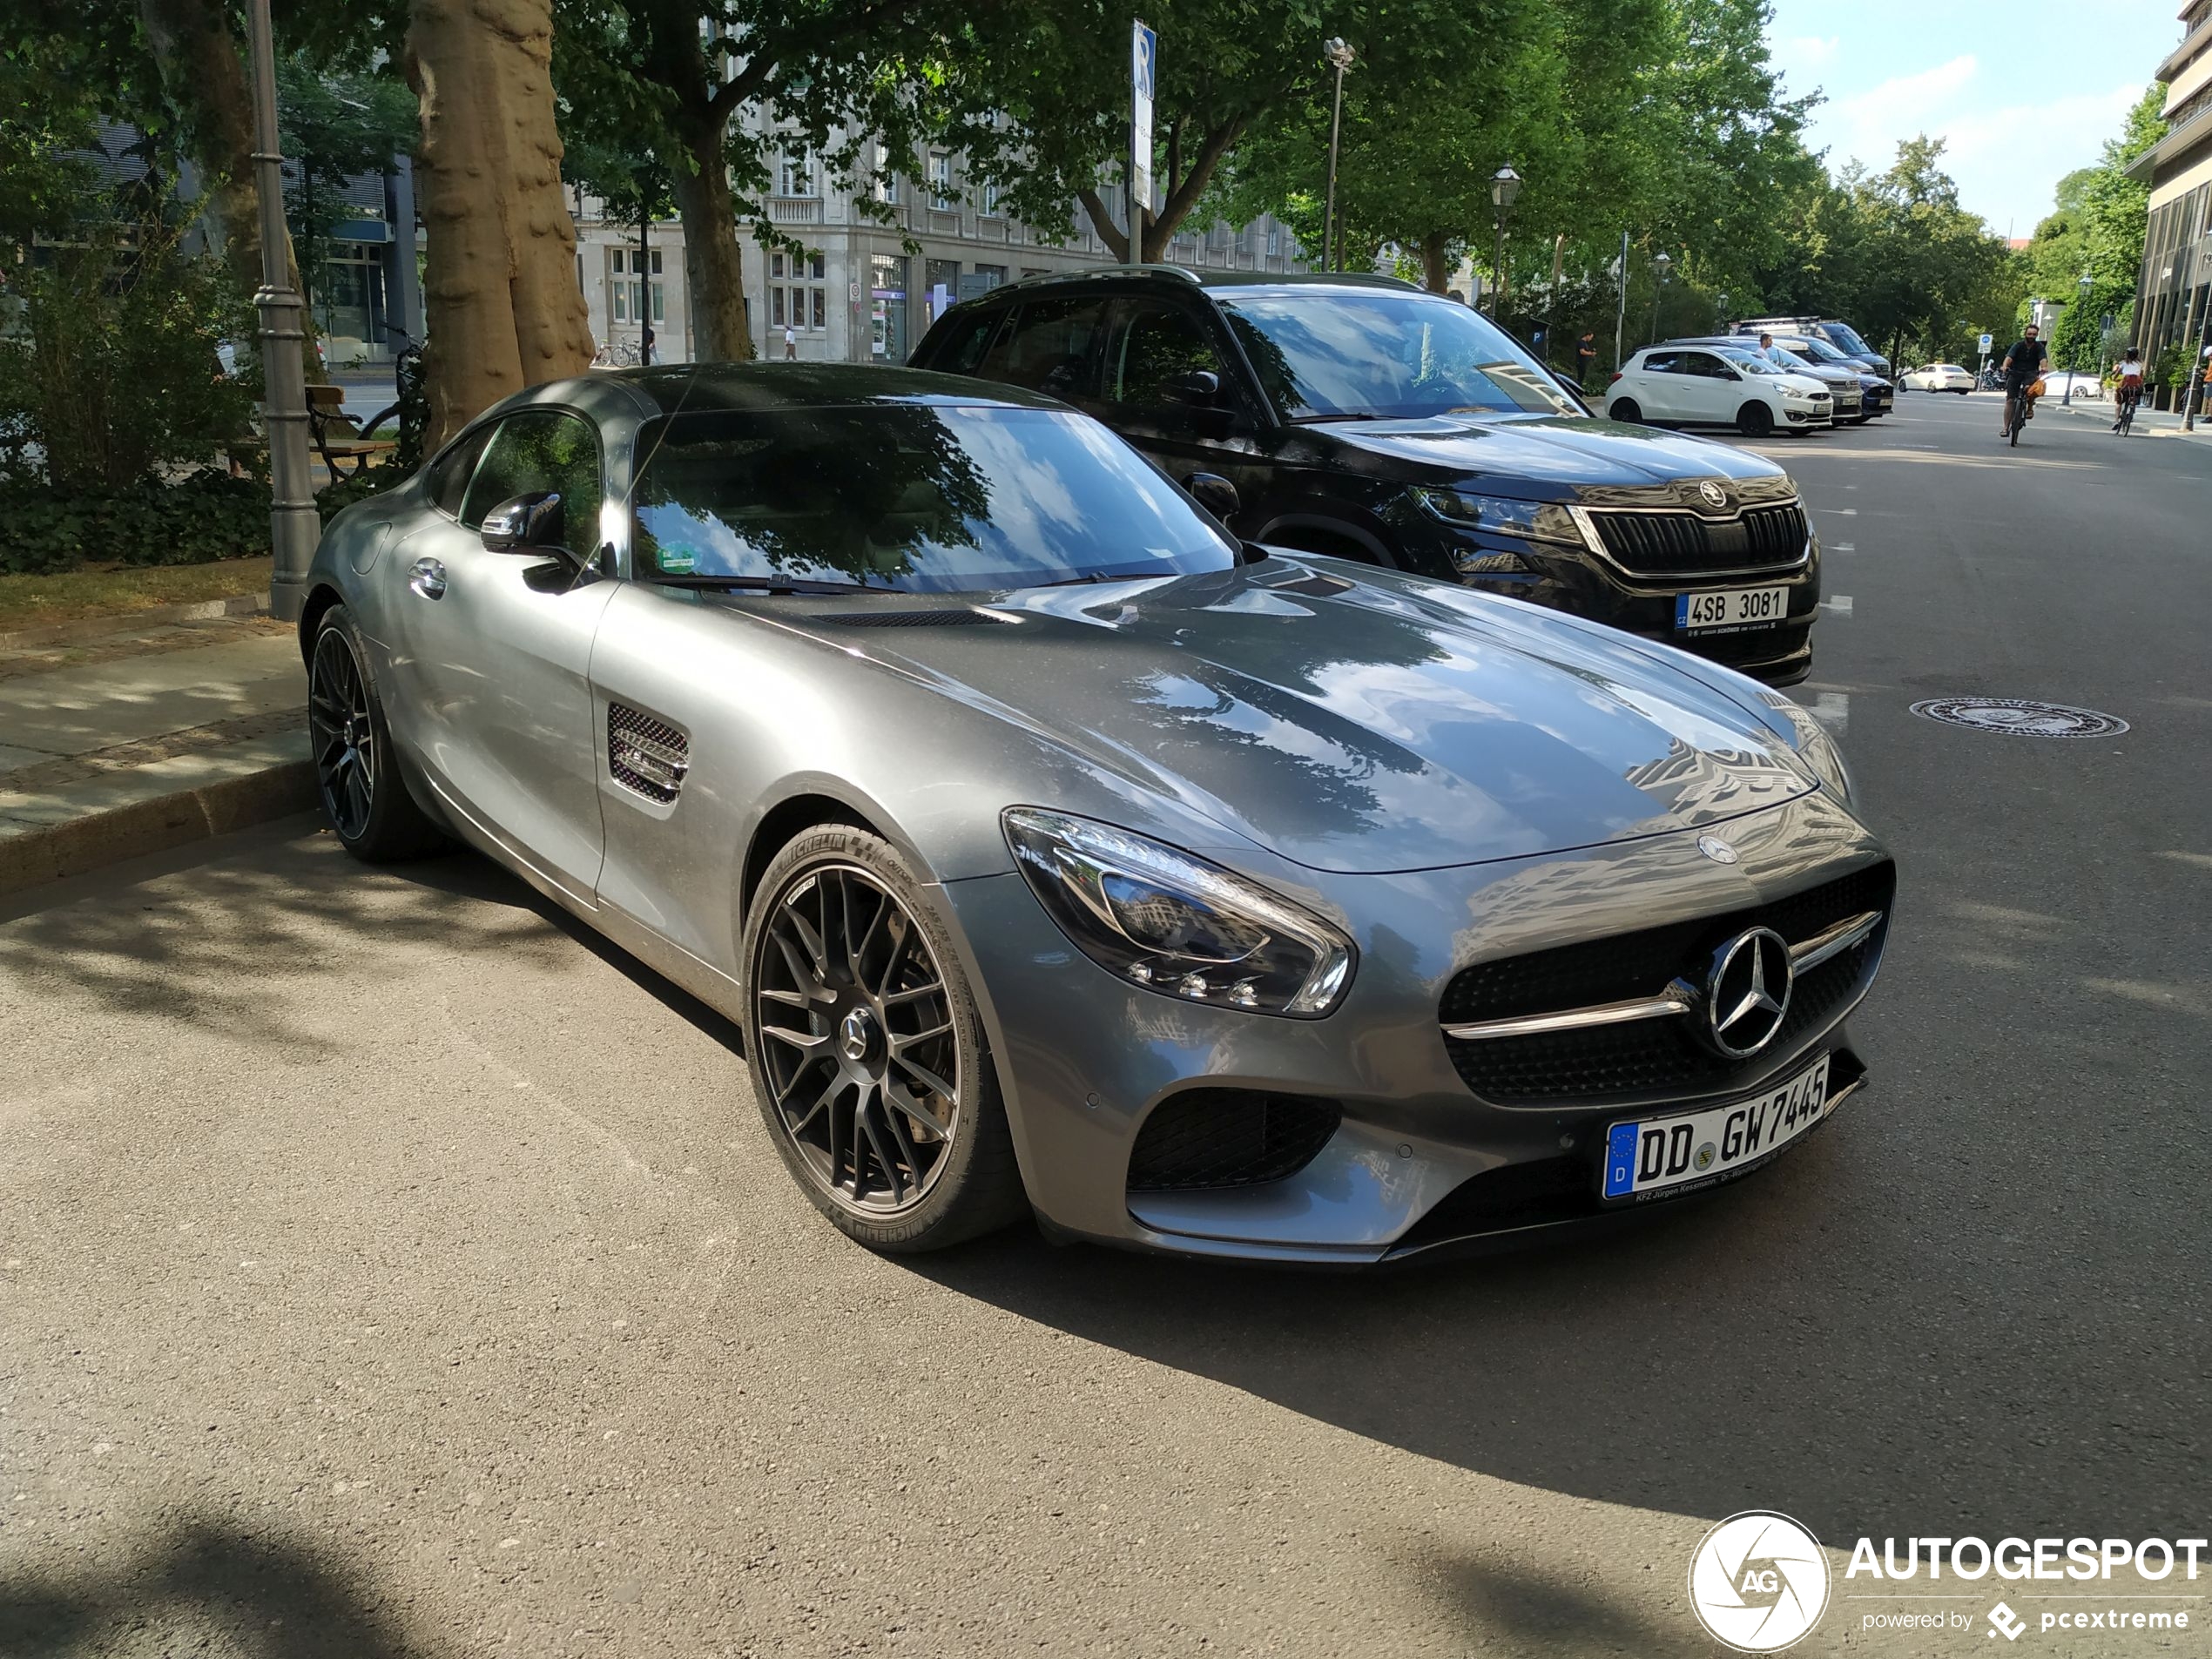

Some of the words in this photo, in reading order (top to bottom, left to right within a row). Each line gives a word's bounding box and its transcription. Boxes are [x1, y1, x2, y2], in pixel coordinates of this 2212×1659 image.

[1534, 333, 1541, 341] P
[1692, 596, 1725, 624] 4SB
[1739, 590, 1780, 619] 3081
[1677, 616, 1687, 625] CZ
[781, 833, 846, 868] MICHELIN
[887, 859, 917, 888] OUTSIDE
[1637, 1123, 1694, 1183] DD
[1615, 1166, 1626, 1183] D
[1635, 1192, 1652, 1202] KFZ
[1652, 1185, 1680, 1200] Jürgen
[1680, 1177, 1716, 1192] Kessmann
[855, 1219, 925, 1244] MICHELIN
